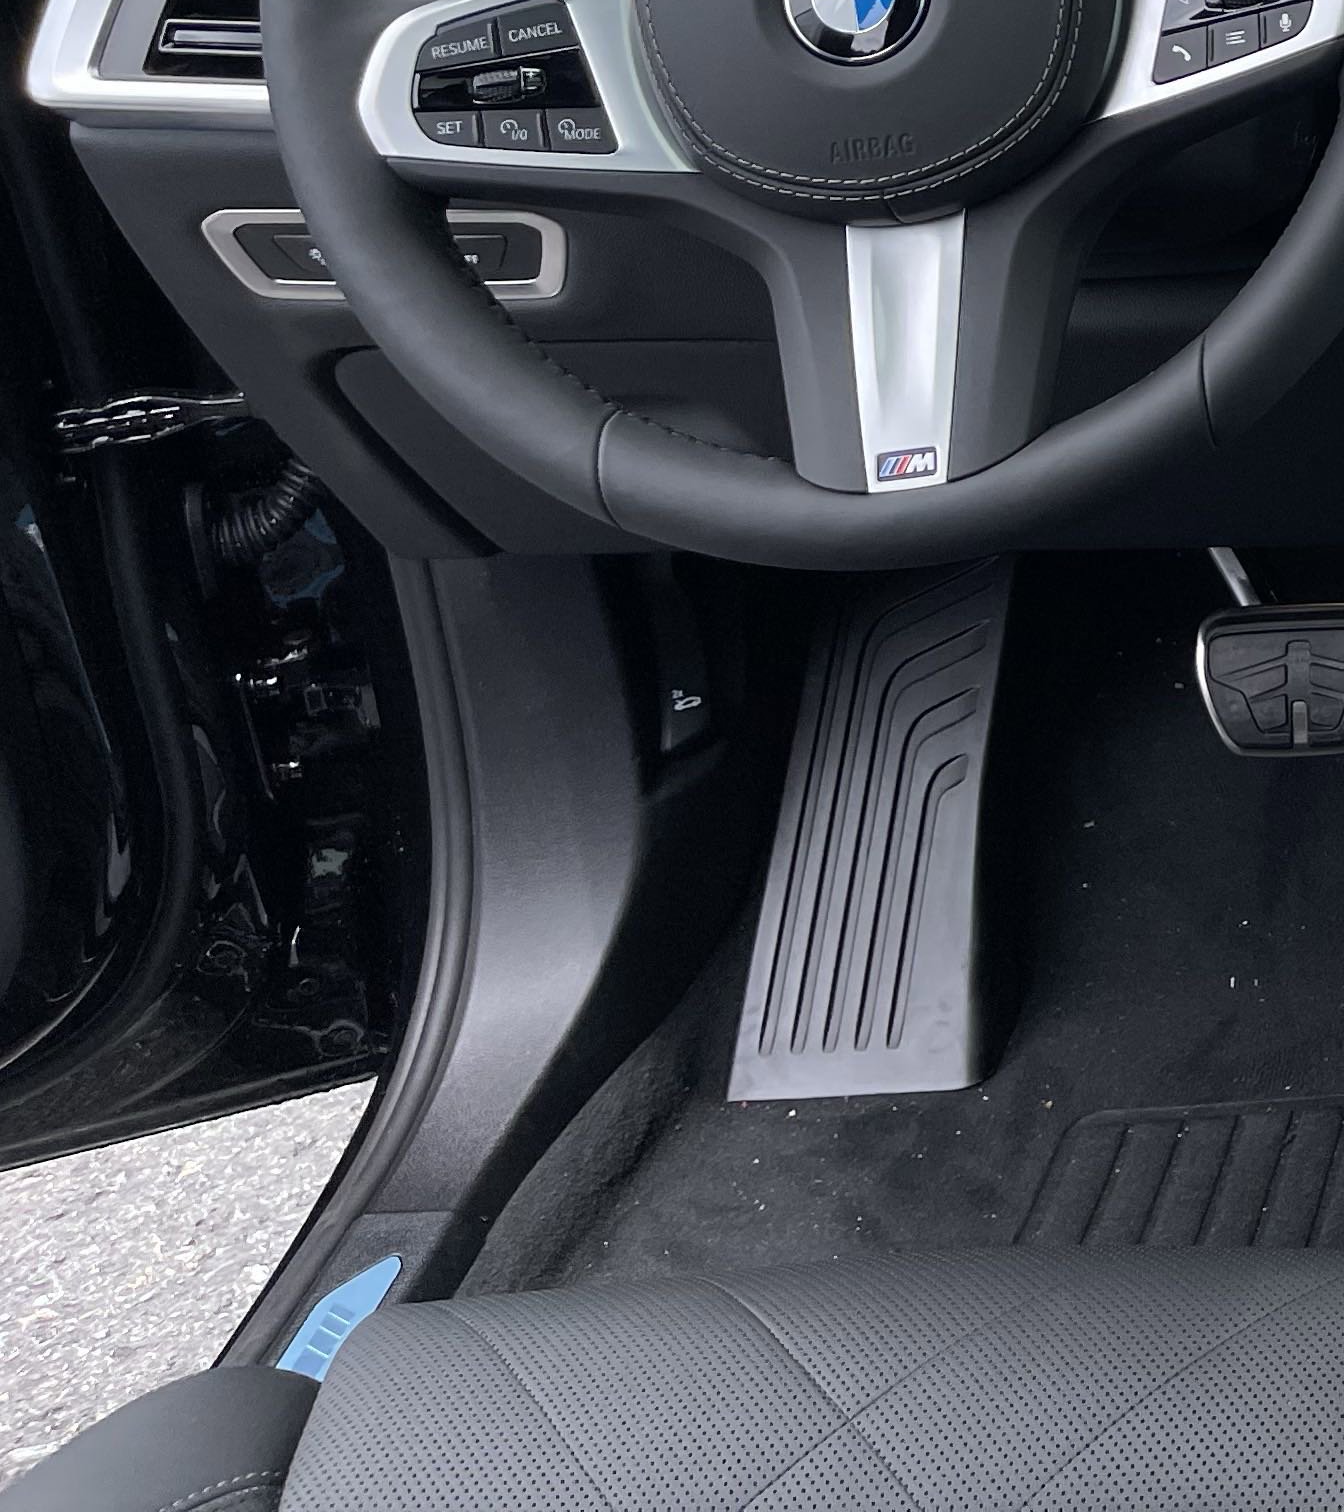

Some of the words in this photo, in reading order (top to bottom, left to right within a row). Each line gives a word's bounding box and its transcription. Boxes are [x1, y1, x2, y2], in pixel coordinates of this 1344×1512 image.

[508, 22, 563, 42] CANCEL
[431, 37, 491, 59] RESUME
[436, 121, 463, 135] SET
[563, 127, 600, 140] MODE
[830, 132, 917, 165] AIRBAG
